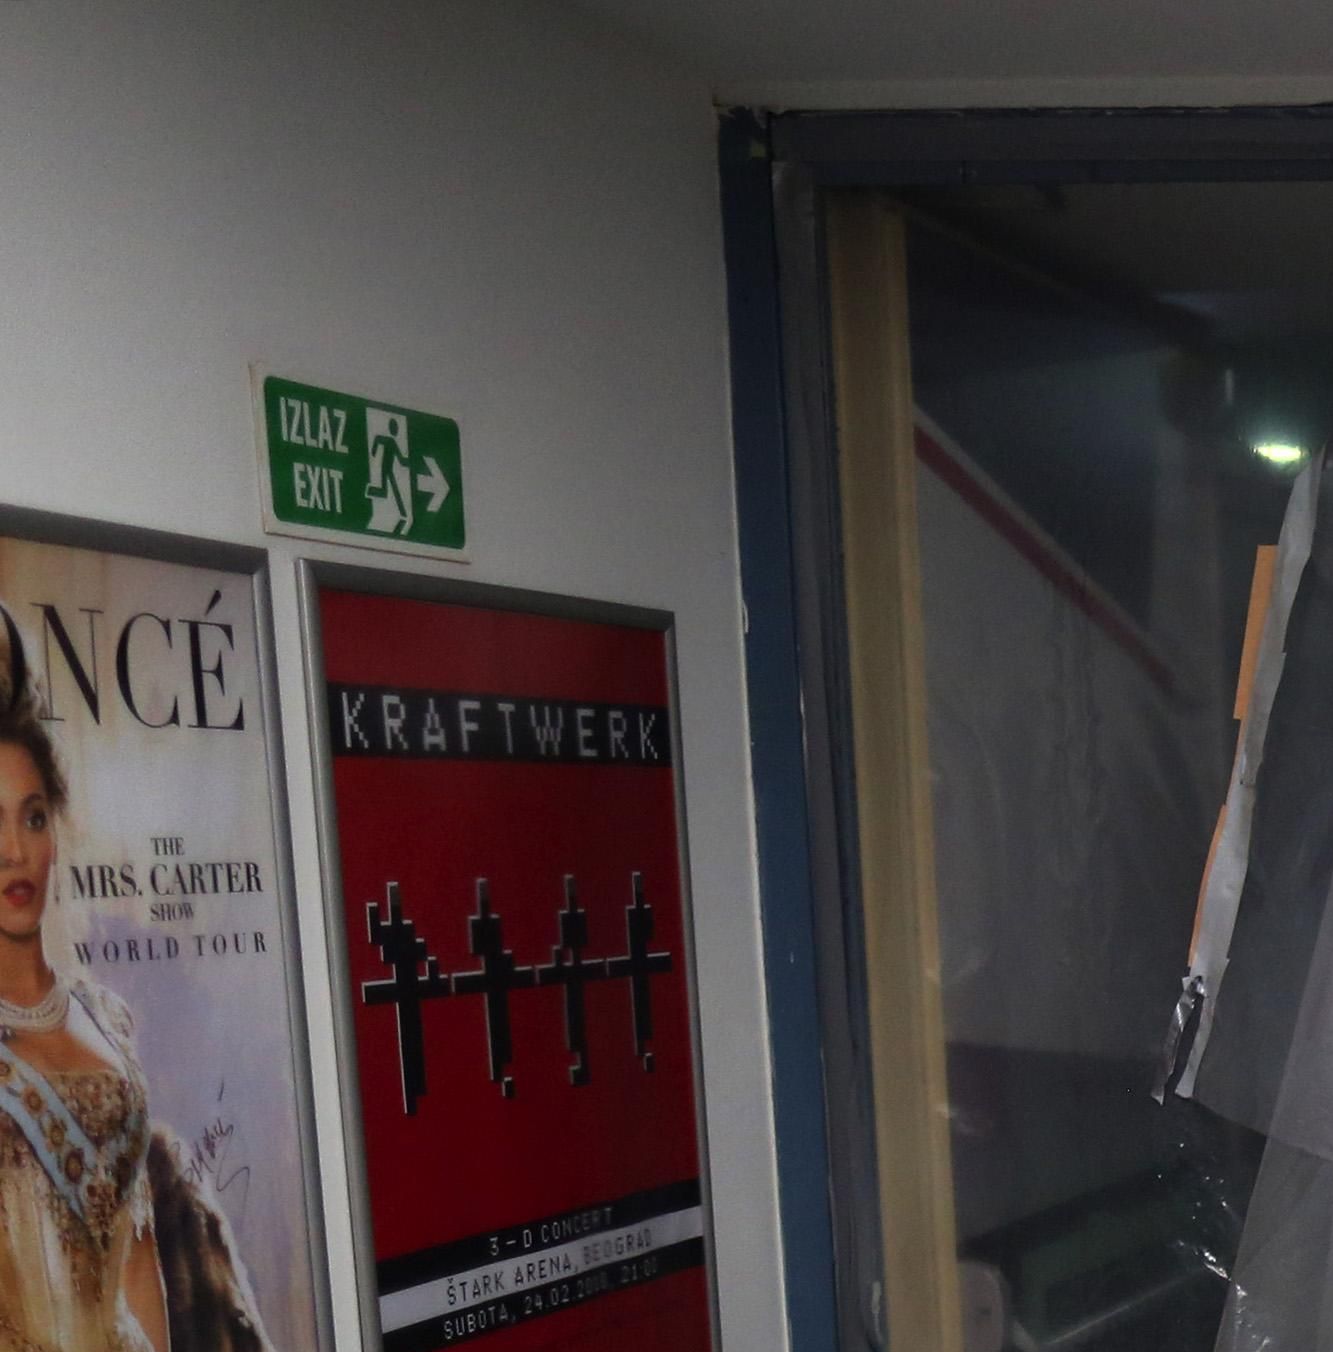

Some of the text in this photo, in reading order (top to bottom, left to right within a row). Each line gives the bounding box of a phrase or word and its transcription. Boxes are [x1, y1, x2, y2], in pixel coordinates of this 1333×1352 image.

[280, 396, 349, 454] IZLAZ
[293, 462, 343, 513] EXIT
[341, 691, 658, 760] KRAFTWERK
[150, 836, 185, 856] THE
[70, 862, 264, 900] MRS. CARTER
[150, 902, 194, 922] SHOW
[74, 930, 267, 966] WORLD TOUR
[540, 1206, 614, 1243] CONCERT
[446, 1228, 652, 1306] ŠTARK ARENA, BEOGRAD
